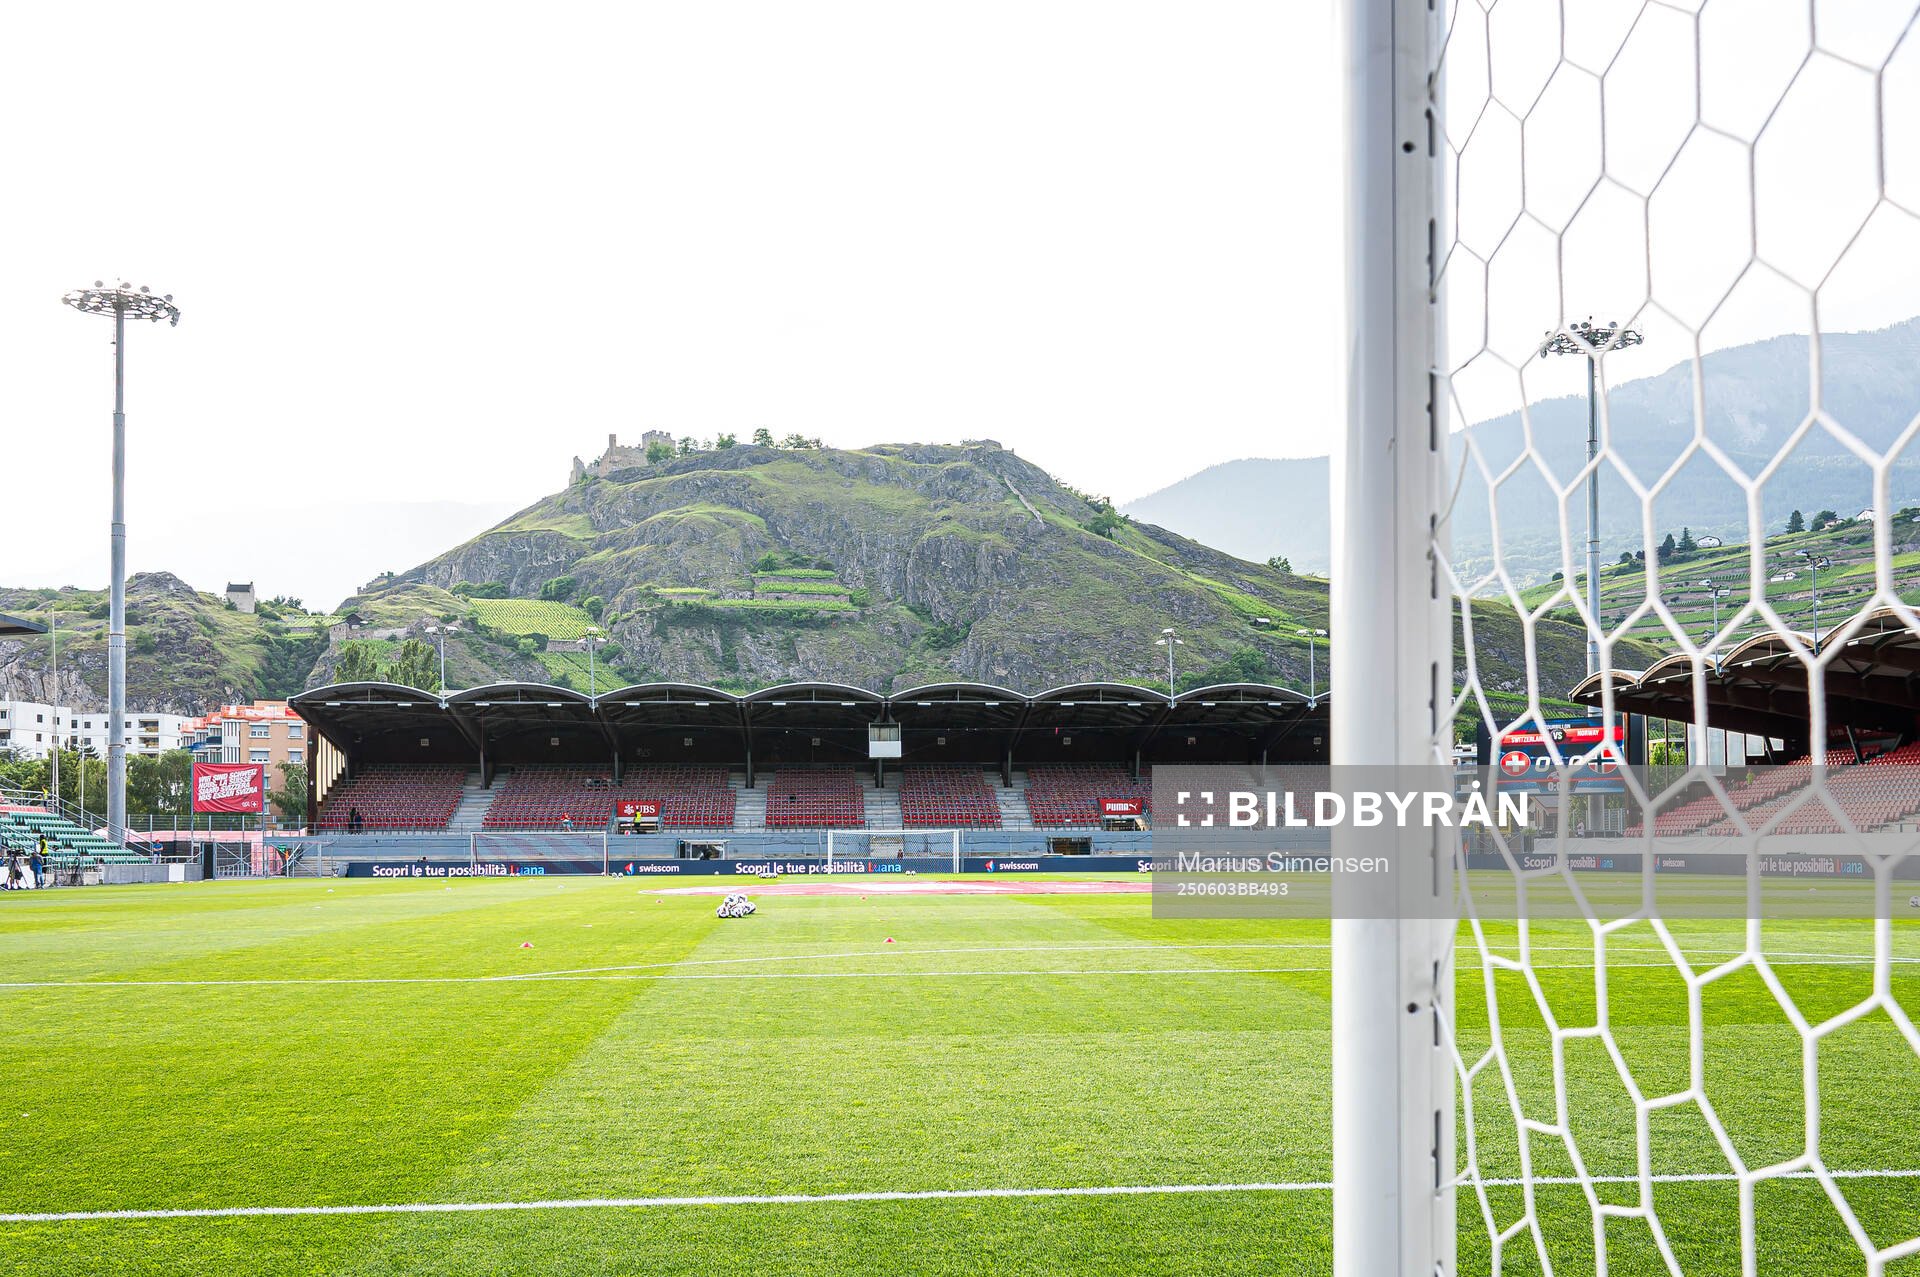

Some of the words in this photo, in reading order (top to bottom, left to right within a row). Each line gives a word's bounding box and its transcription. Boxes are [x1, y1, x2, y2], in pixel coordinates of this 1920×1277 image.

[1511, 735, 1546, 743] SWITZERLAN
[1552, 732, 1563, 740] VS
[1577, 729, 1599, 737] NORWAY
[636, 804, 655, 814] UBS
[1106, 803, 1129, 811] PUMA
[639, 864, 680, 873] swisscom
[735, 862, 771, 875] Scopri
[773, 862, 784, 873] le
[786, 863, 806, 873] tue
[868, 862, 902, 873] Luana
[999, 861, 1039, 871] swisscom
[1137, 859, 1172, 872] Scopri
[1523, 856, 1552, 869] Scopri
[1569, 856, 1596, 870] possibilità
[1662, 859, 1686, 868] swisscom
[1769, 858, 1777, 872] le
[1778, 859, 1792, 872] tue
[1793, 858, 1835, 876] possibilità
[1836, 860, 1863, 874] Luana
[372, 864, 409, 878] Scopri
[411, 864, 423, 876] le
[425, 865, 445, 876] tue
[448, 863, 507, 878] possibilità
